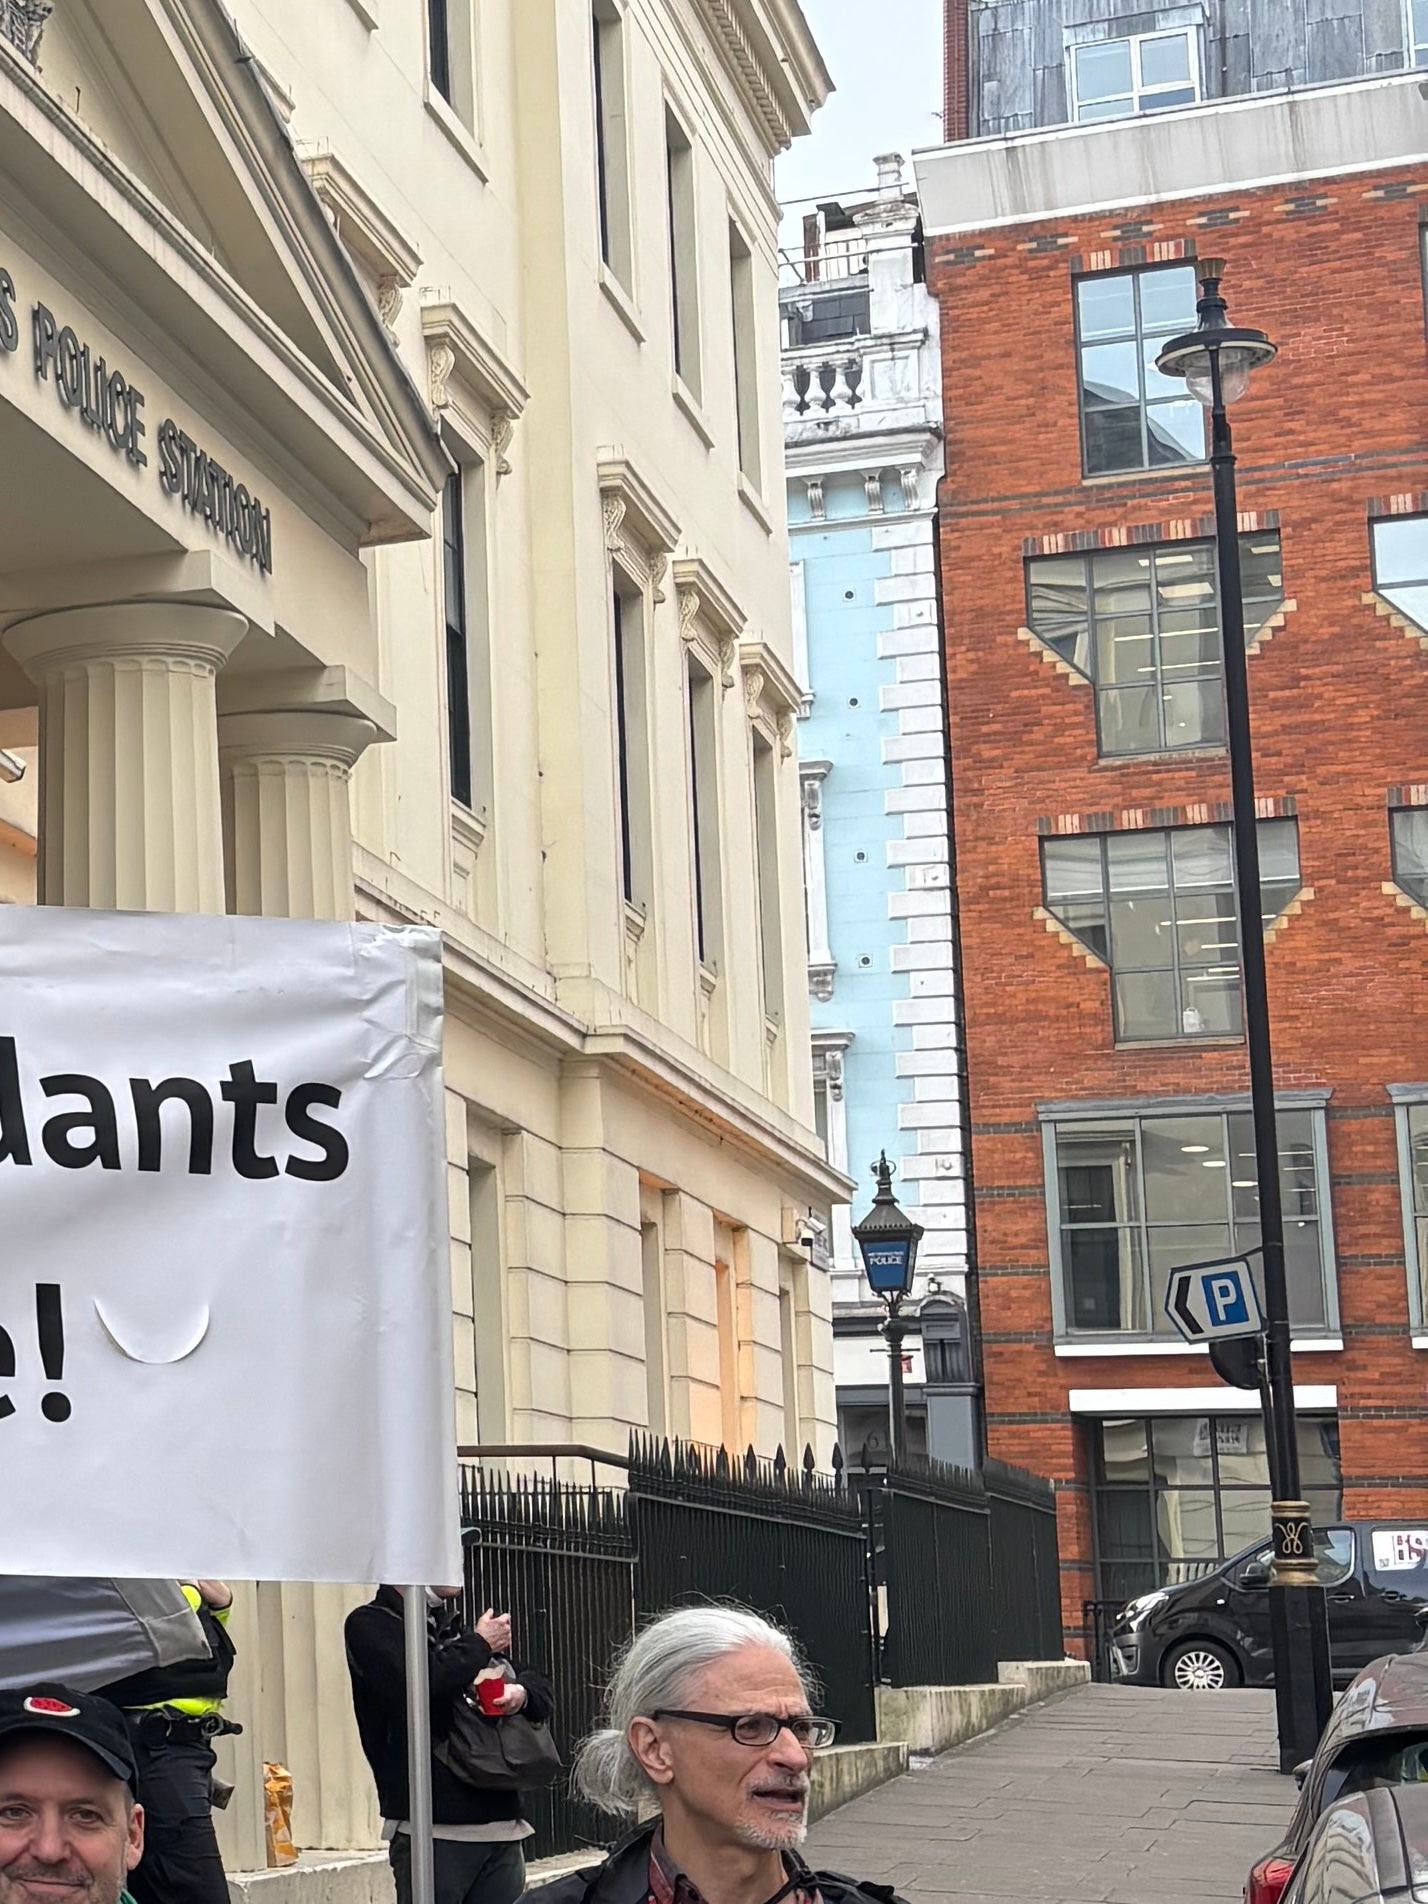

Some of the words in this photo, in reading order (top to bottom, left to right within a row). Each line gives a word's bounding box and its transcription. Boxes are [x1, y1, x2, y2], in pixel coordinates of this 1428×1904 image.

[33, 301, 148, 467] POLICE
[159, 418, 274, 575] STATION
[1211, 1279, 1238, 1321] P
